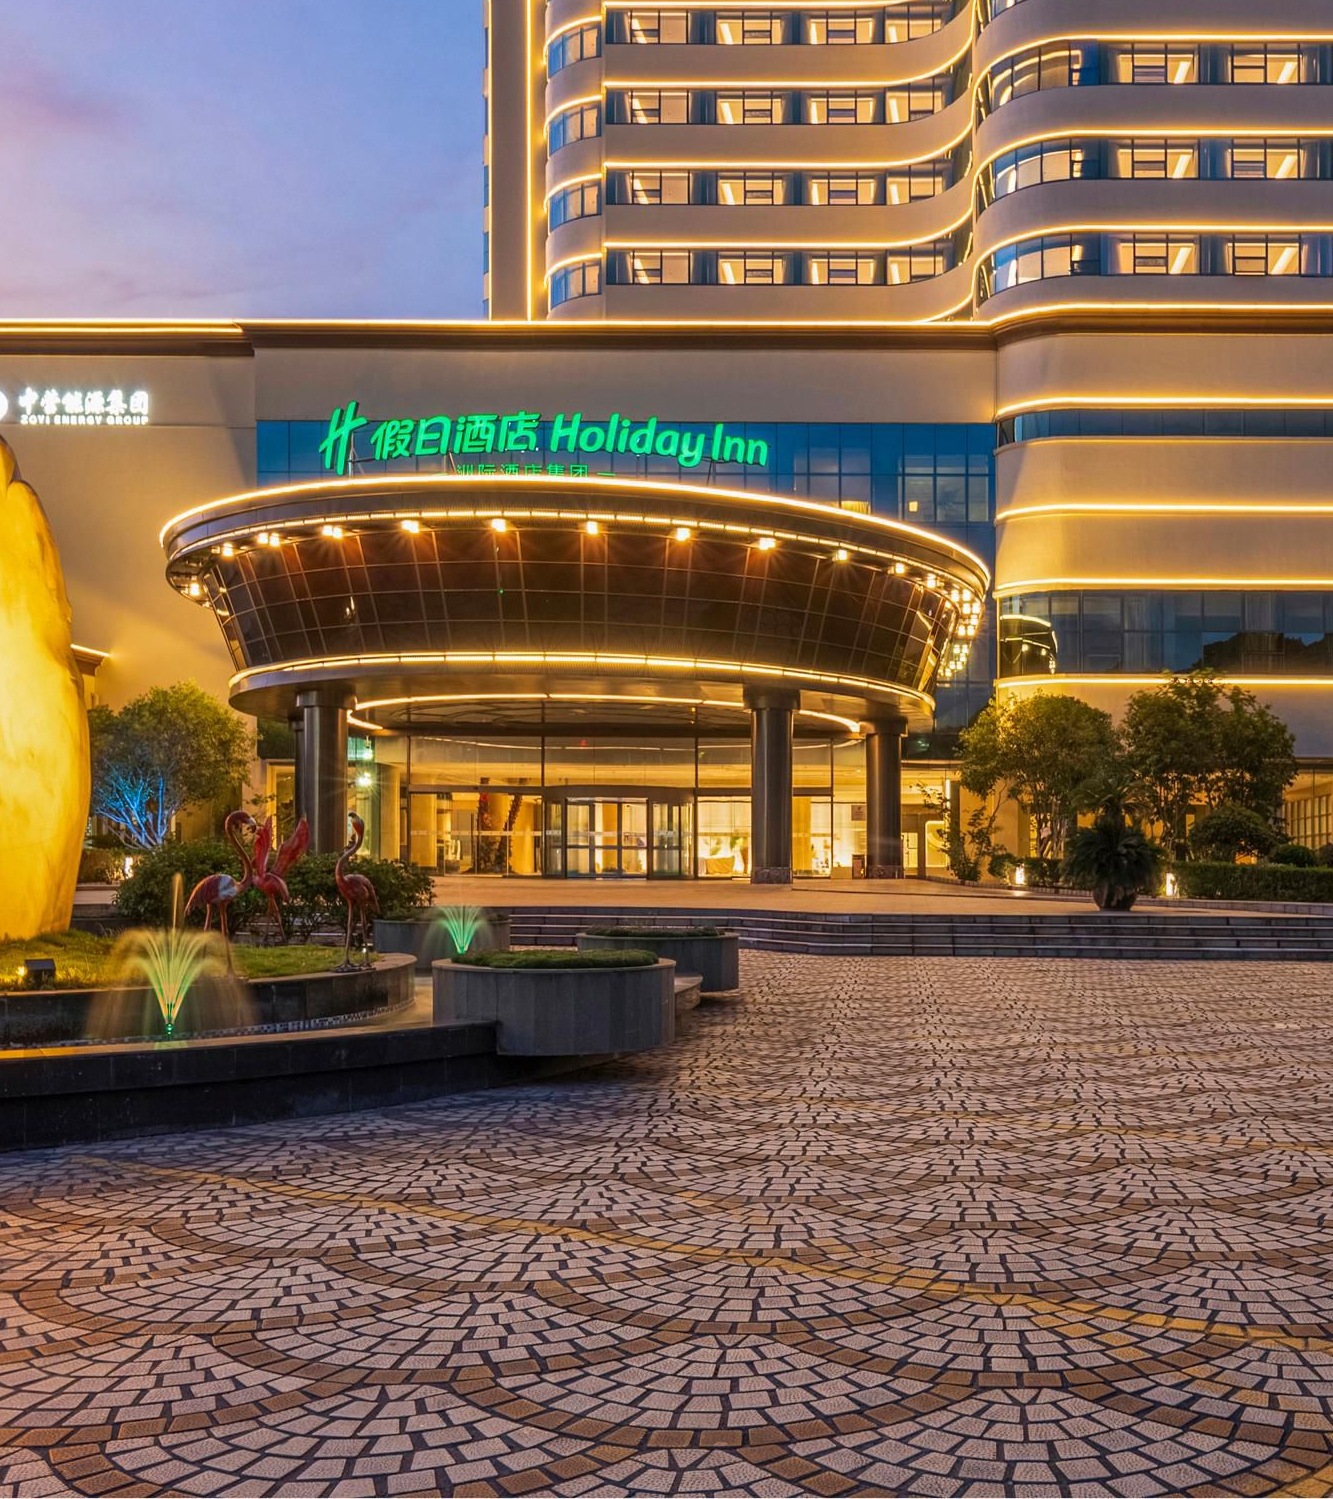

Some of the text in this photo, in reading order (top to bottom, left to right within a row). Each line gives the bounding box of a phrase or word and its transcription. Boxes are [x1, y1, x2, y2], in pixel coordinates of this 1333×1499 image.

[54, 414, 102, 425] ENERGY
[106, 414, 149, 425] GROUP
[369, 410, 541, 461] 假日酒店
[549, 411, 706, 468] Holiday
[710, 422, 769, 467] Inn
